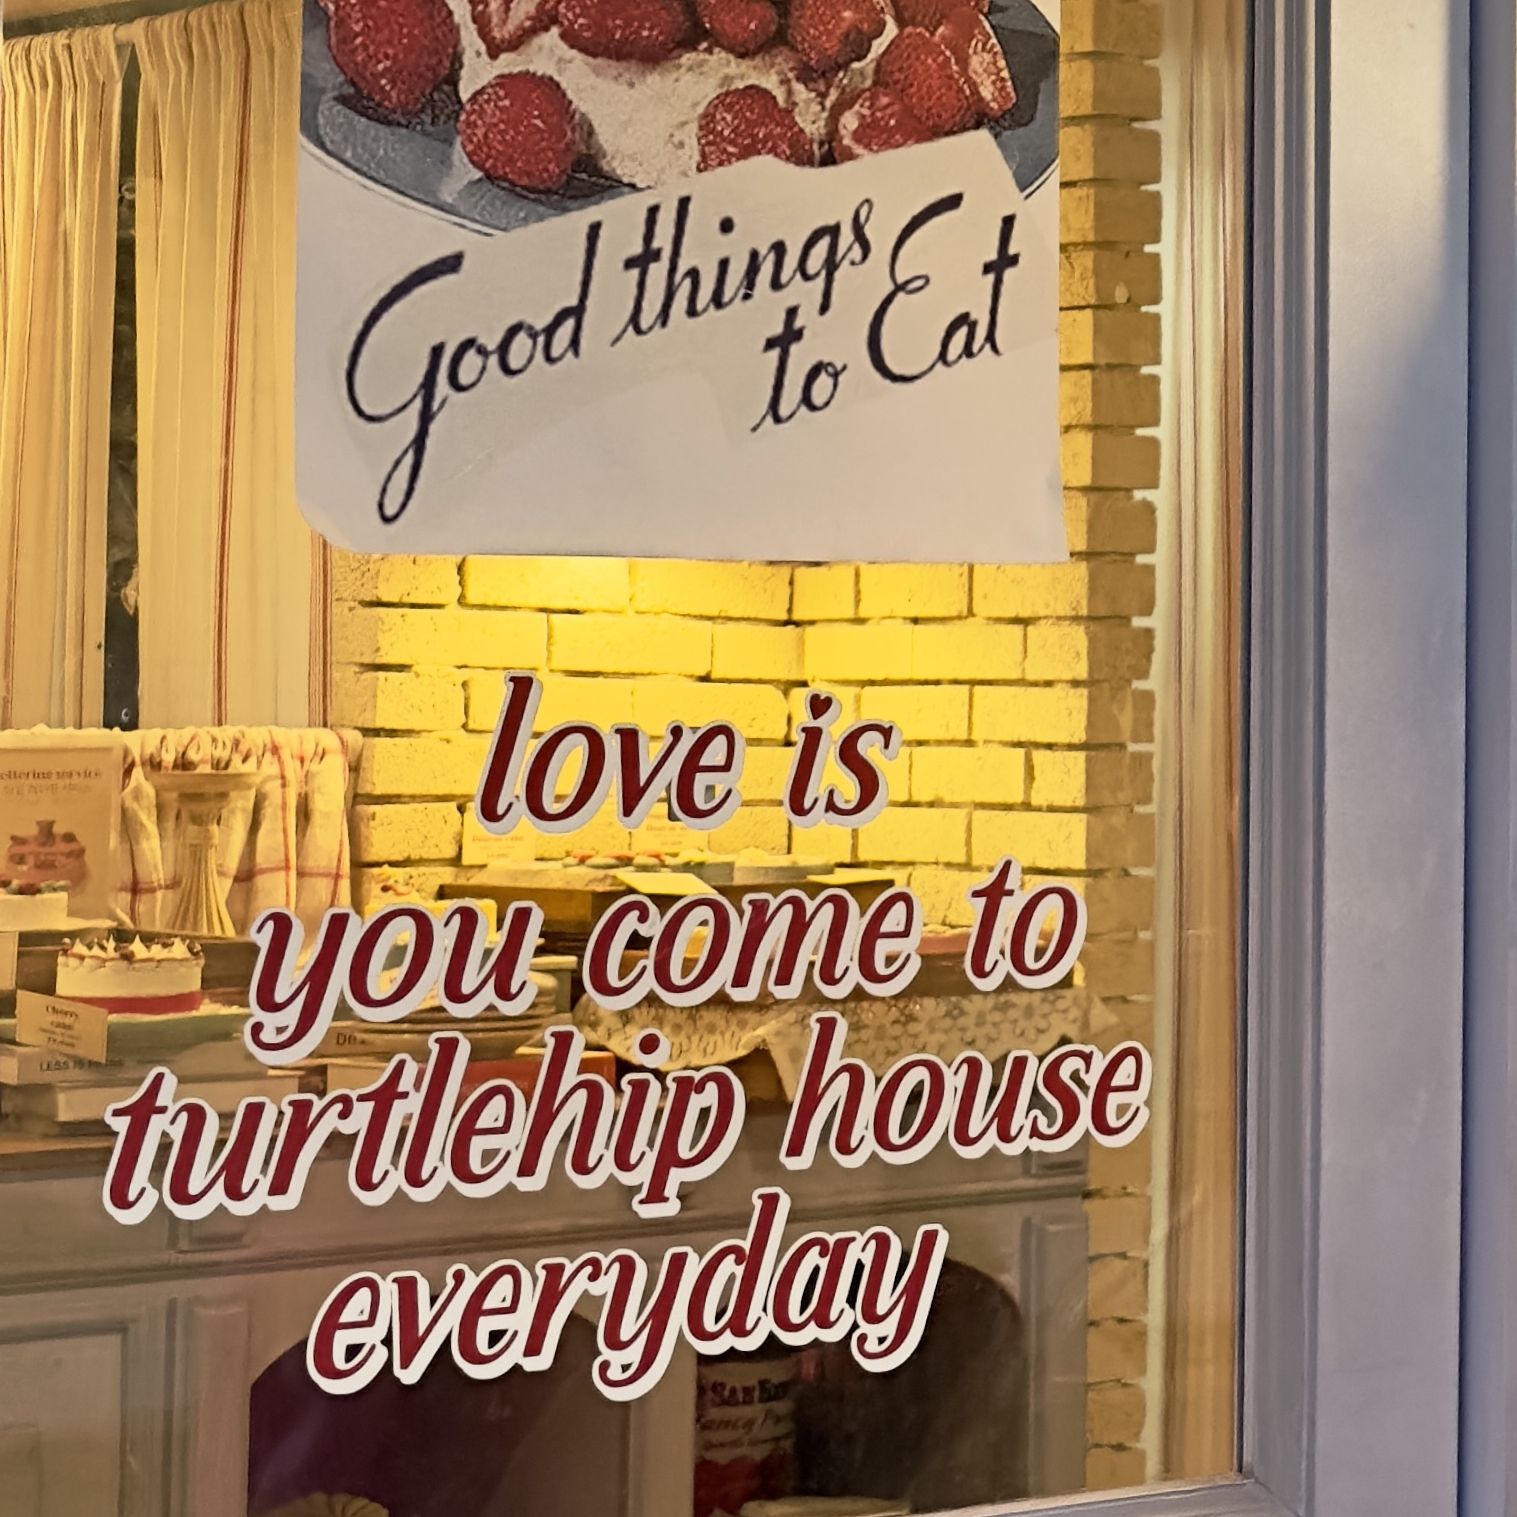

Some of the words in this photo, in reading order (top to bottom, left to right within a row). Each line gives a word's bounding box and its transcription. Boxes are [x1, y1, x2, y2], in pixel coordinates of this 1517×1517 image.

[345, 219, 603, 523] Good
[610, 194, 874, 347] things
[750, 305, 849, 433] to
[866, 192, 1021, 383] Eat
[478, 674, 736, 824] love
[787, 693, 894, 818] is
[250, 904, 535, 1053] you
[587, 890, 915, 998] come
[970, 860, 1078, 980] to
[107, 1029, 736, 1210] turtlehip
[785, 1017, 1144, 1159] house
[312, 1191, 942, 1389] everyday
